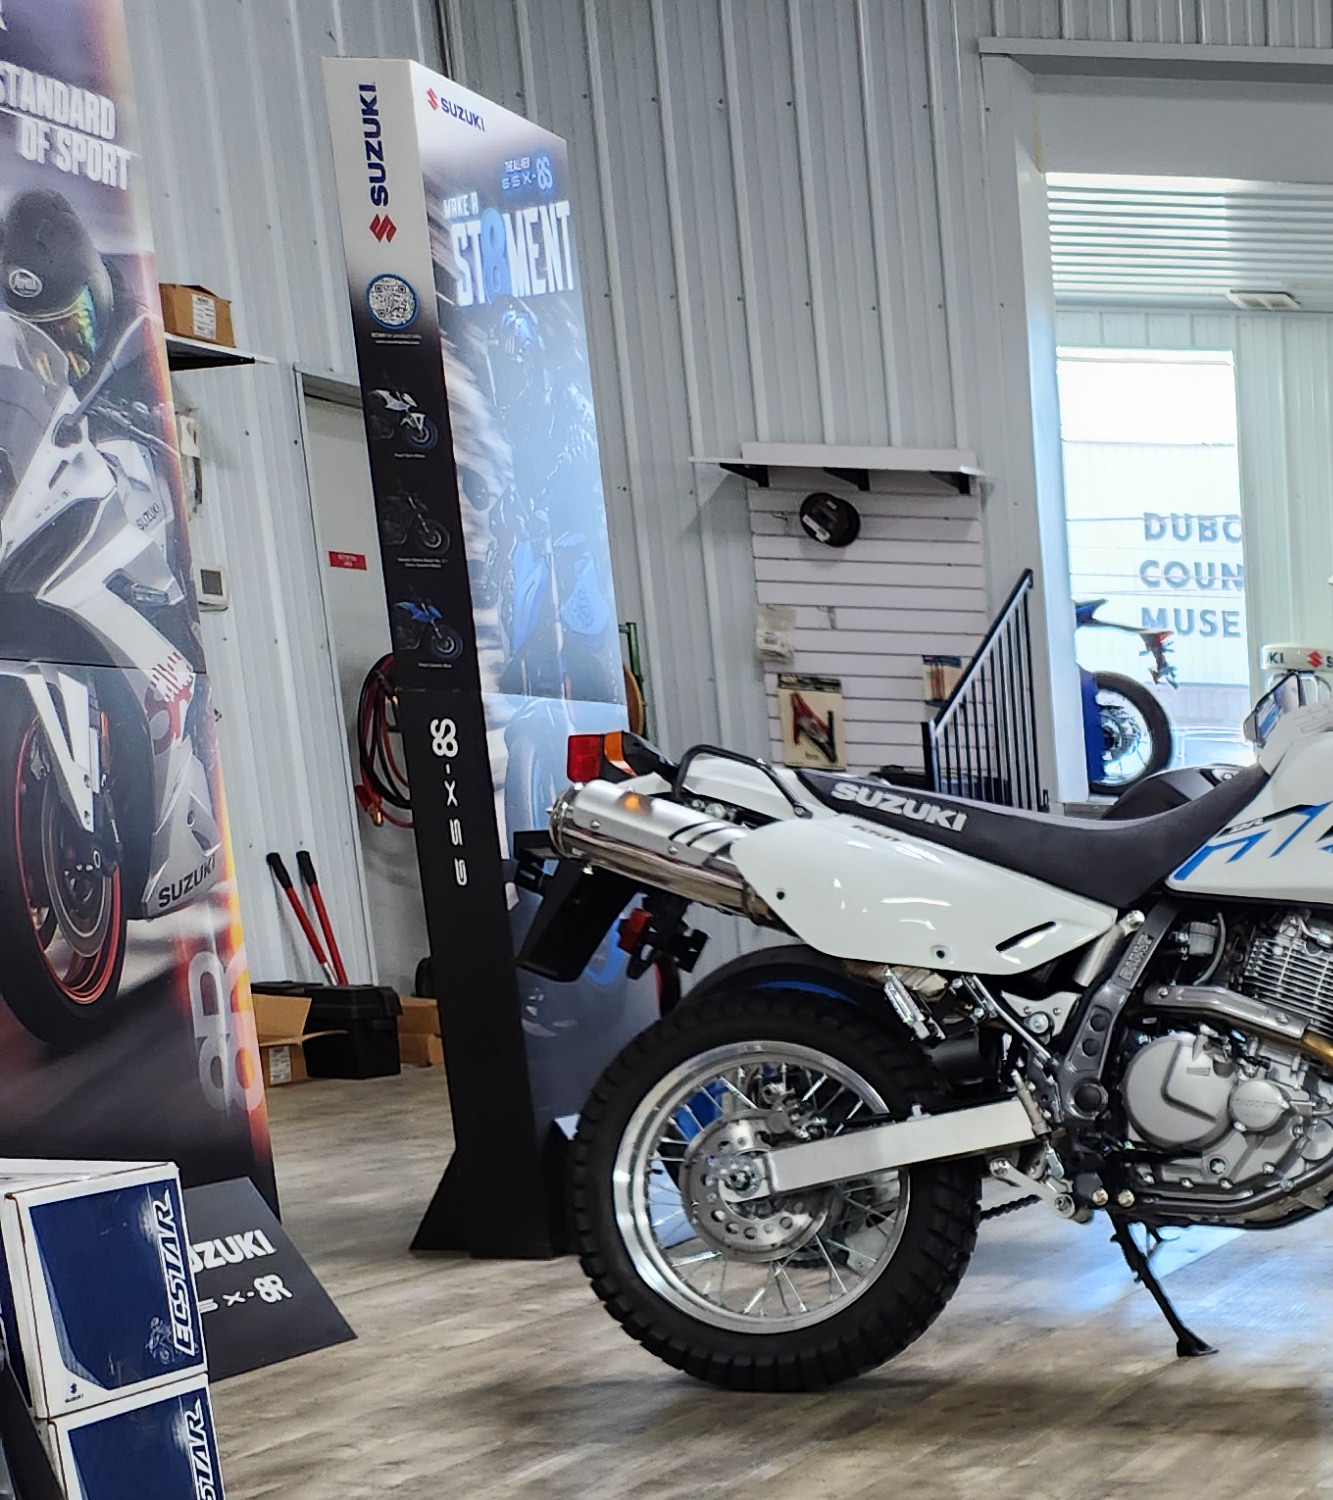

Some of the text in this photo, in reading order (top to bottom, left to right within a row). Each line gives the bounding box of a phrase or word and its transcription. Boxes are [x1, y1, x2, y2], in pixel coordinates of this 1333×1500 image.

[440, 97, 486, 132] SUZUKI
[20, 117, 131, 191] OF SPORT
[359, 84, 389, 207] SUZUKI
[443, 191, 479, 220] MAKE A
[1141, 607, 1242, 638] MUSE
[831, 781, 969, 833] SUZUKI
[158, 855, 216, 908] SUZUKI
[152, 1187, 196, 1357] ECSTAR
[189, 1229, 277, 1274] UZUKI
